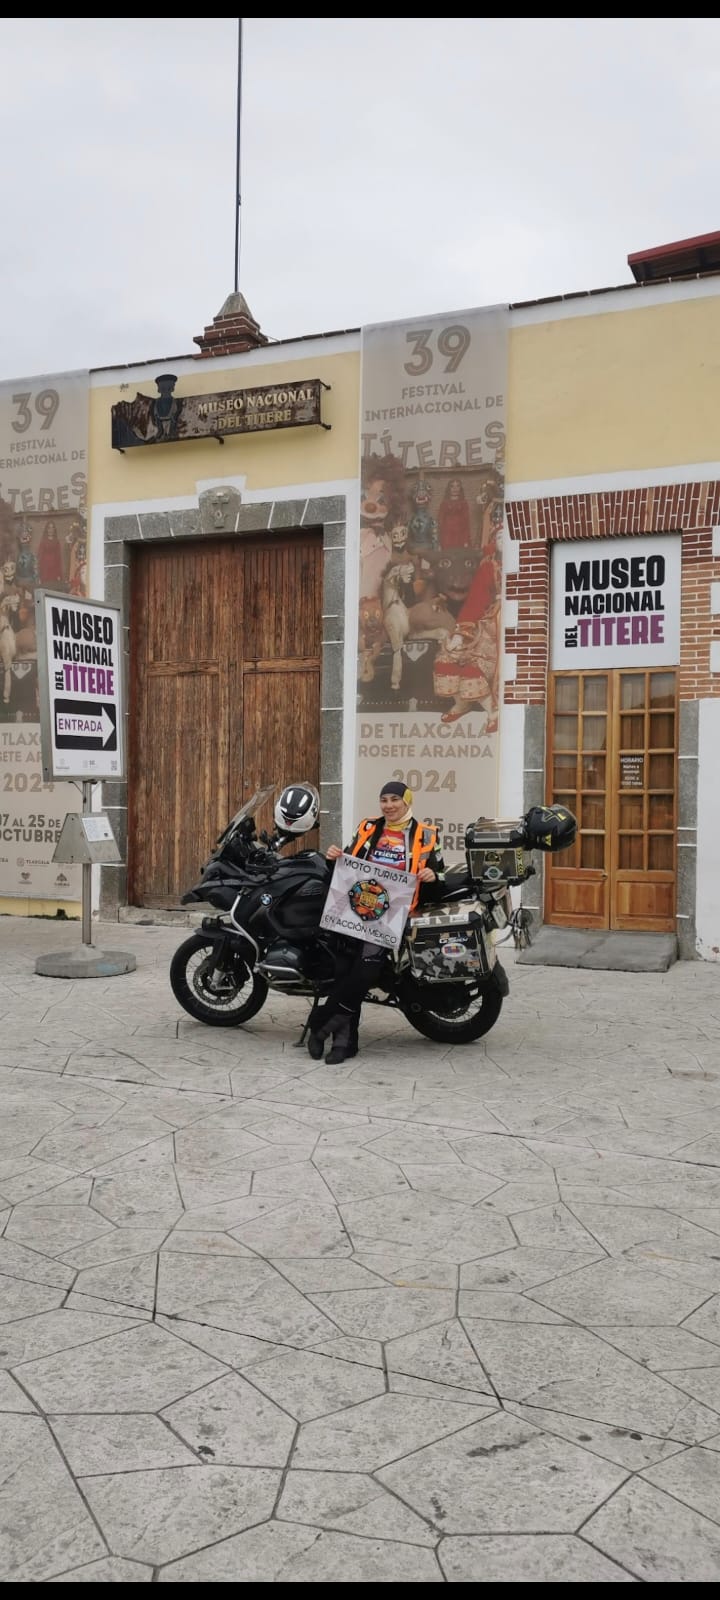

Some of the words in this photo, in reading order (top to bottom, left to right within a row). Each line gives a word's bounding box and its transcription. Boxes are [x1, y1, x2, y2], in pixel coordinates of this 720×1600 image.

[404, 325, 471, 376] 39
[198, 398, 244, 415] MUSEO
[246, 388, 314, 407] NACIONAL
[401, 382, 466, 400] FESTIVAL
[11, 388, 60, 434] 39
[364, 398, 481, 421] INTERNACIONAL
[485, 395, 504, 408] DE
[217, 414, 241, 429] DEL
[10, 438, 56, 453] FESTIVAL
[71, 449, 86, 460] DE
[361, 421, 505, 470] TÍTERES
[565, 555, 666, 592] MUSEO
[565, 590, 665, 616] NACIONAL
[51, 606, 114, 646] MUSEO
[565, 625, 578, 648] DEL
[577, 614, 665, 647] TÍTERE
[53, 639, 114, 667] NACIONAL
[55, 670, 64, 690] DEL
[63, 662, 115, 696] TÍTERE
[58, 718, 103, 732] ENTRADA
[361, 723, 384, 739] DE
[389, 722, 492, 739] TLAXCALA
[358, 744, 416, 757] ROSETE
[420, 744, 493, 758] ARANDA
[12, 818, 25, 827] AL
[28, 814, 45, 828] 25
[48, 818, 61, 829] DE
[448, 823, 465, 834] DE
[0, 828, 62, 843] CTUBRE
[343, 858, 372, 874] MOTO
[374, 867, 408, 885] TURISTA
[324, 915, 335, 924] EN
[336, 918, 368, 933] ACCIÓN
